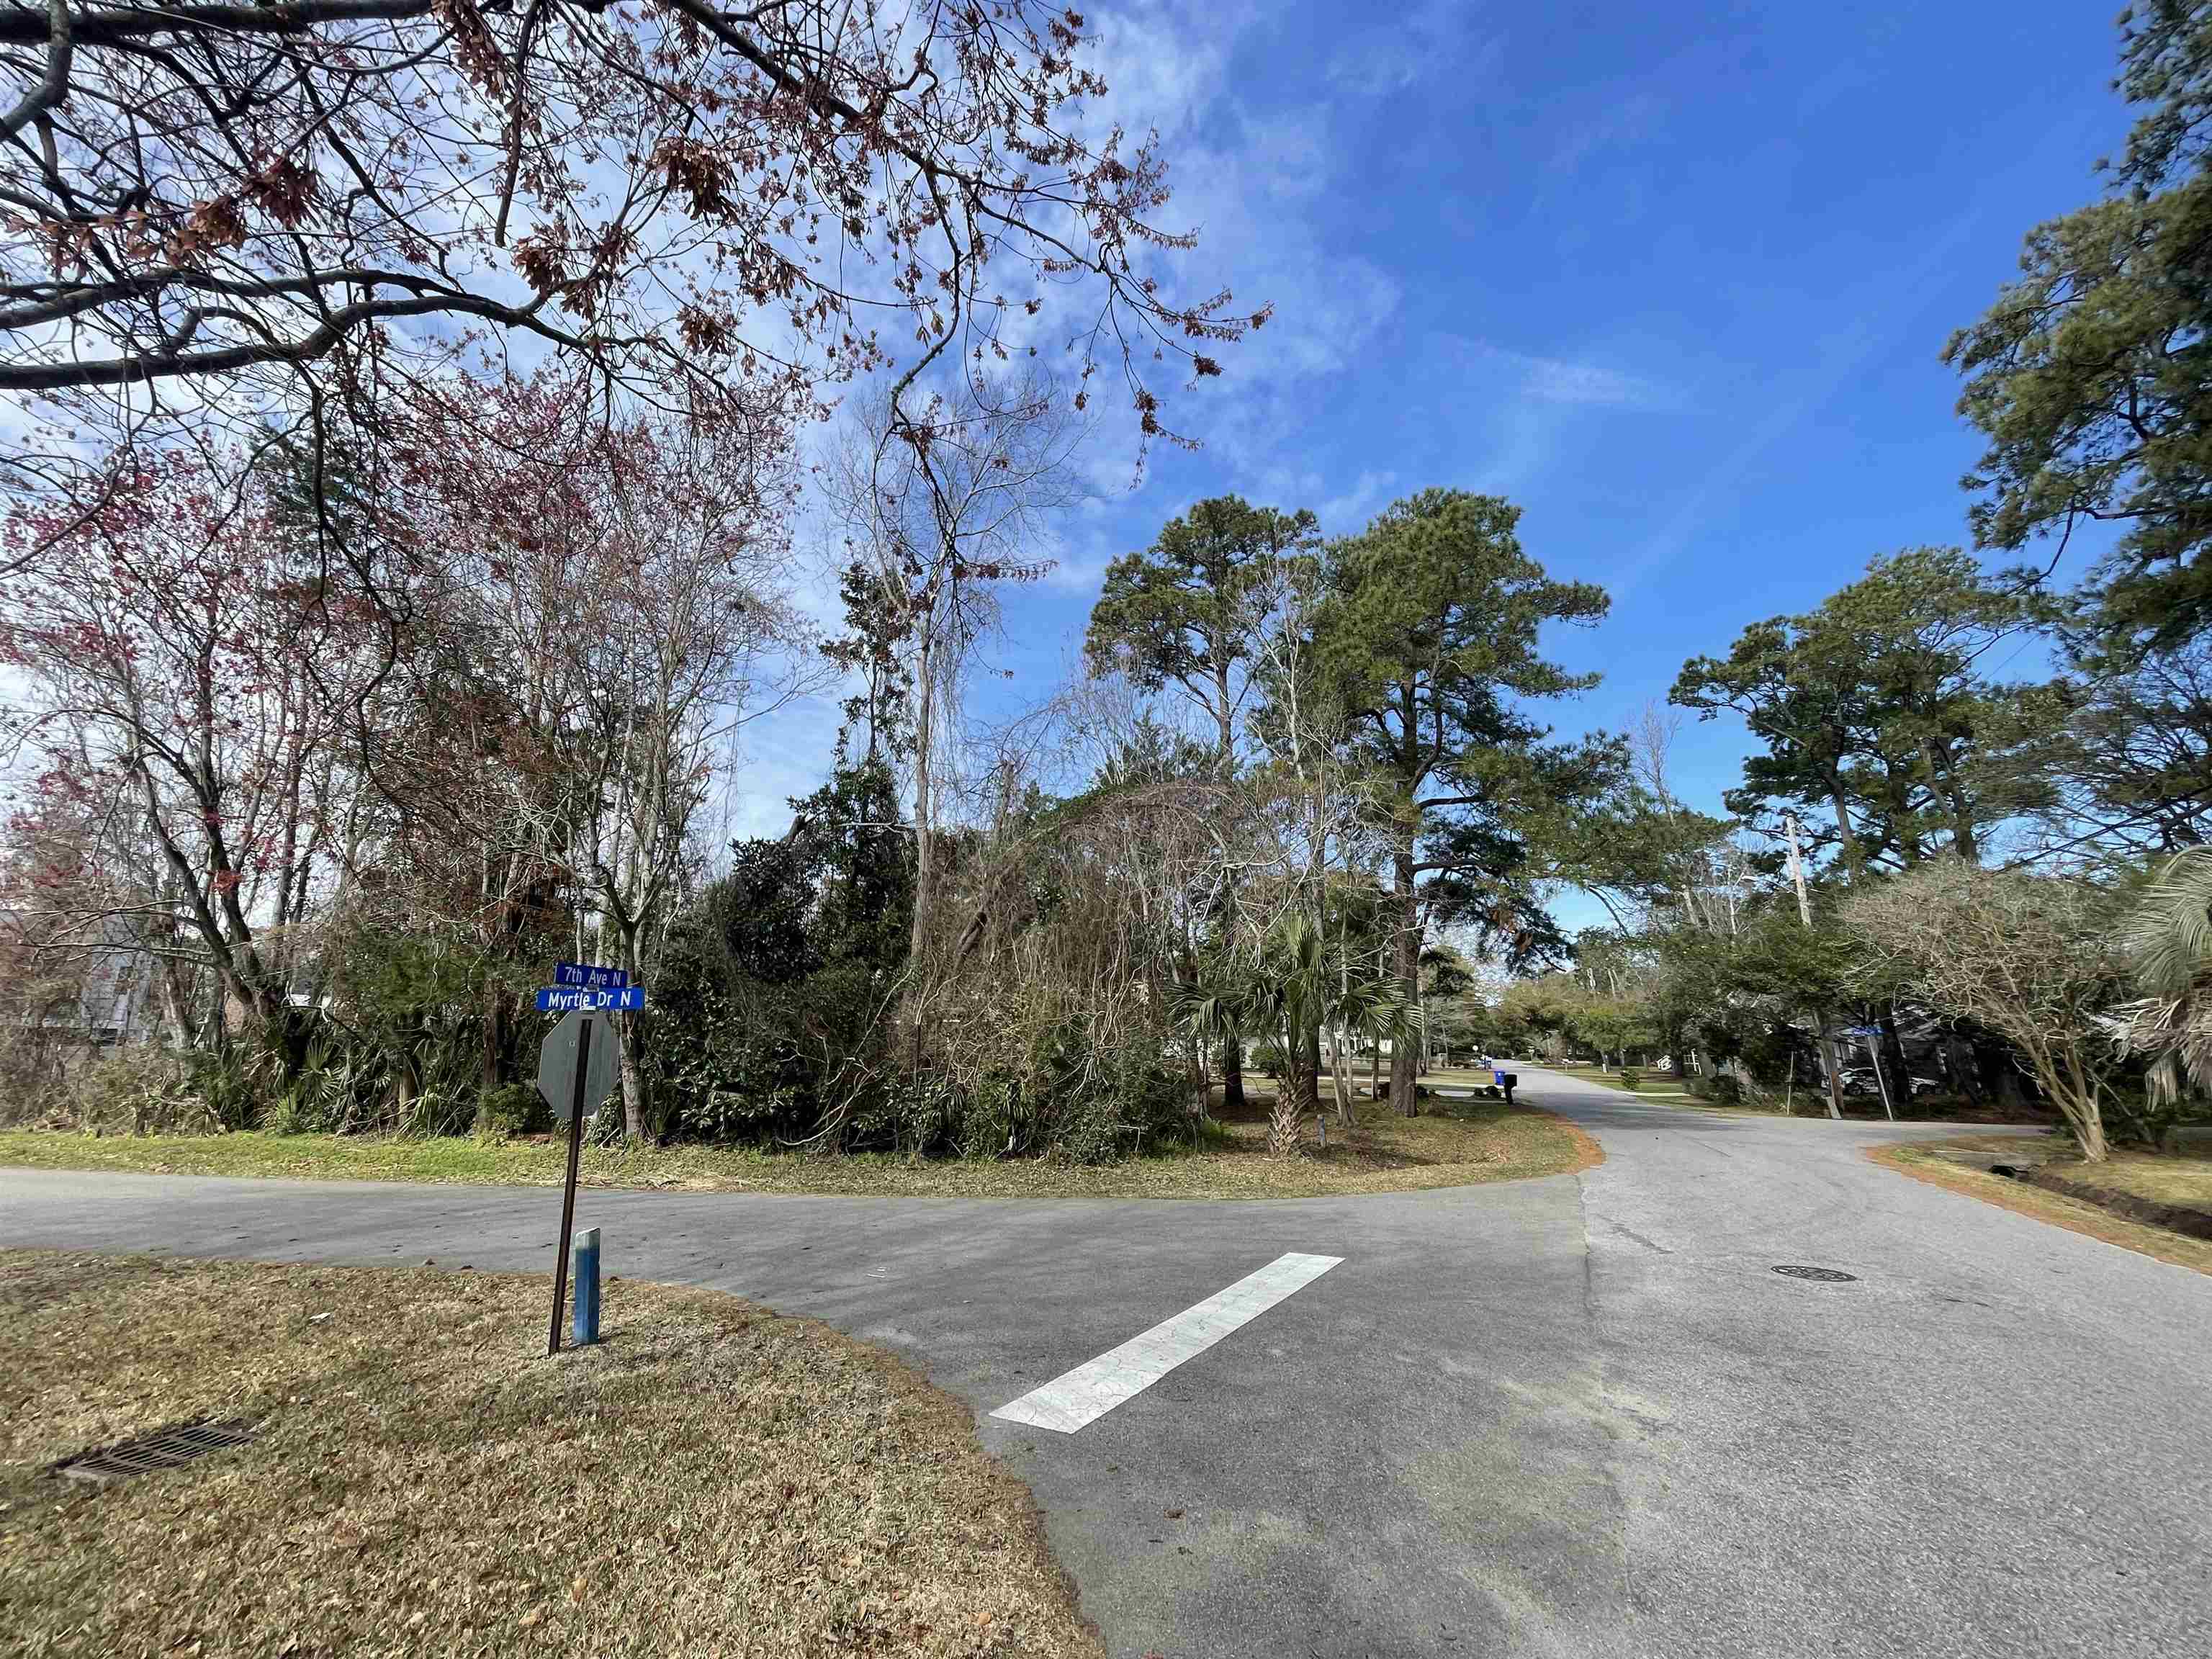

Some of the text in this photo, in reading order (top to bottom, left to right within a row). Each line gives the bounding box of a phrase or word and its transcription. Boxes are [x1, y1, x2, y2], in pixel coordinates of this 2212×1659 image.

[565, 967, 621, 986] 7th Ave N
[548, 991, 631, 1010] Myrtle Dr N
